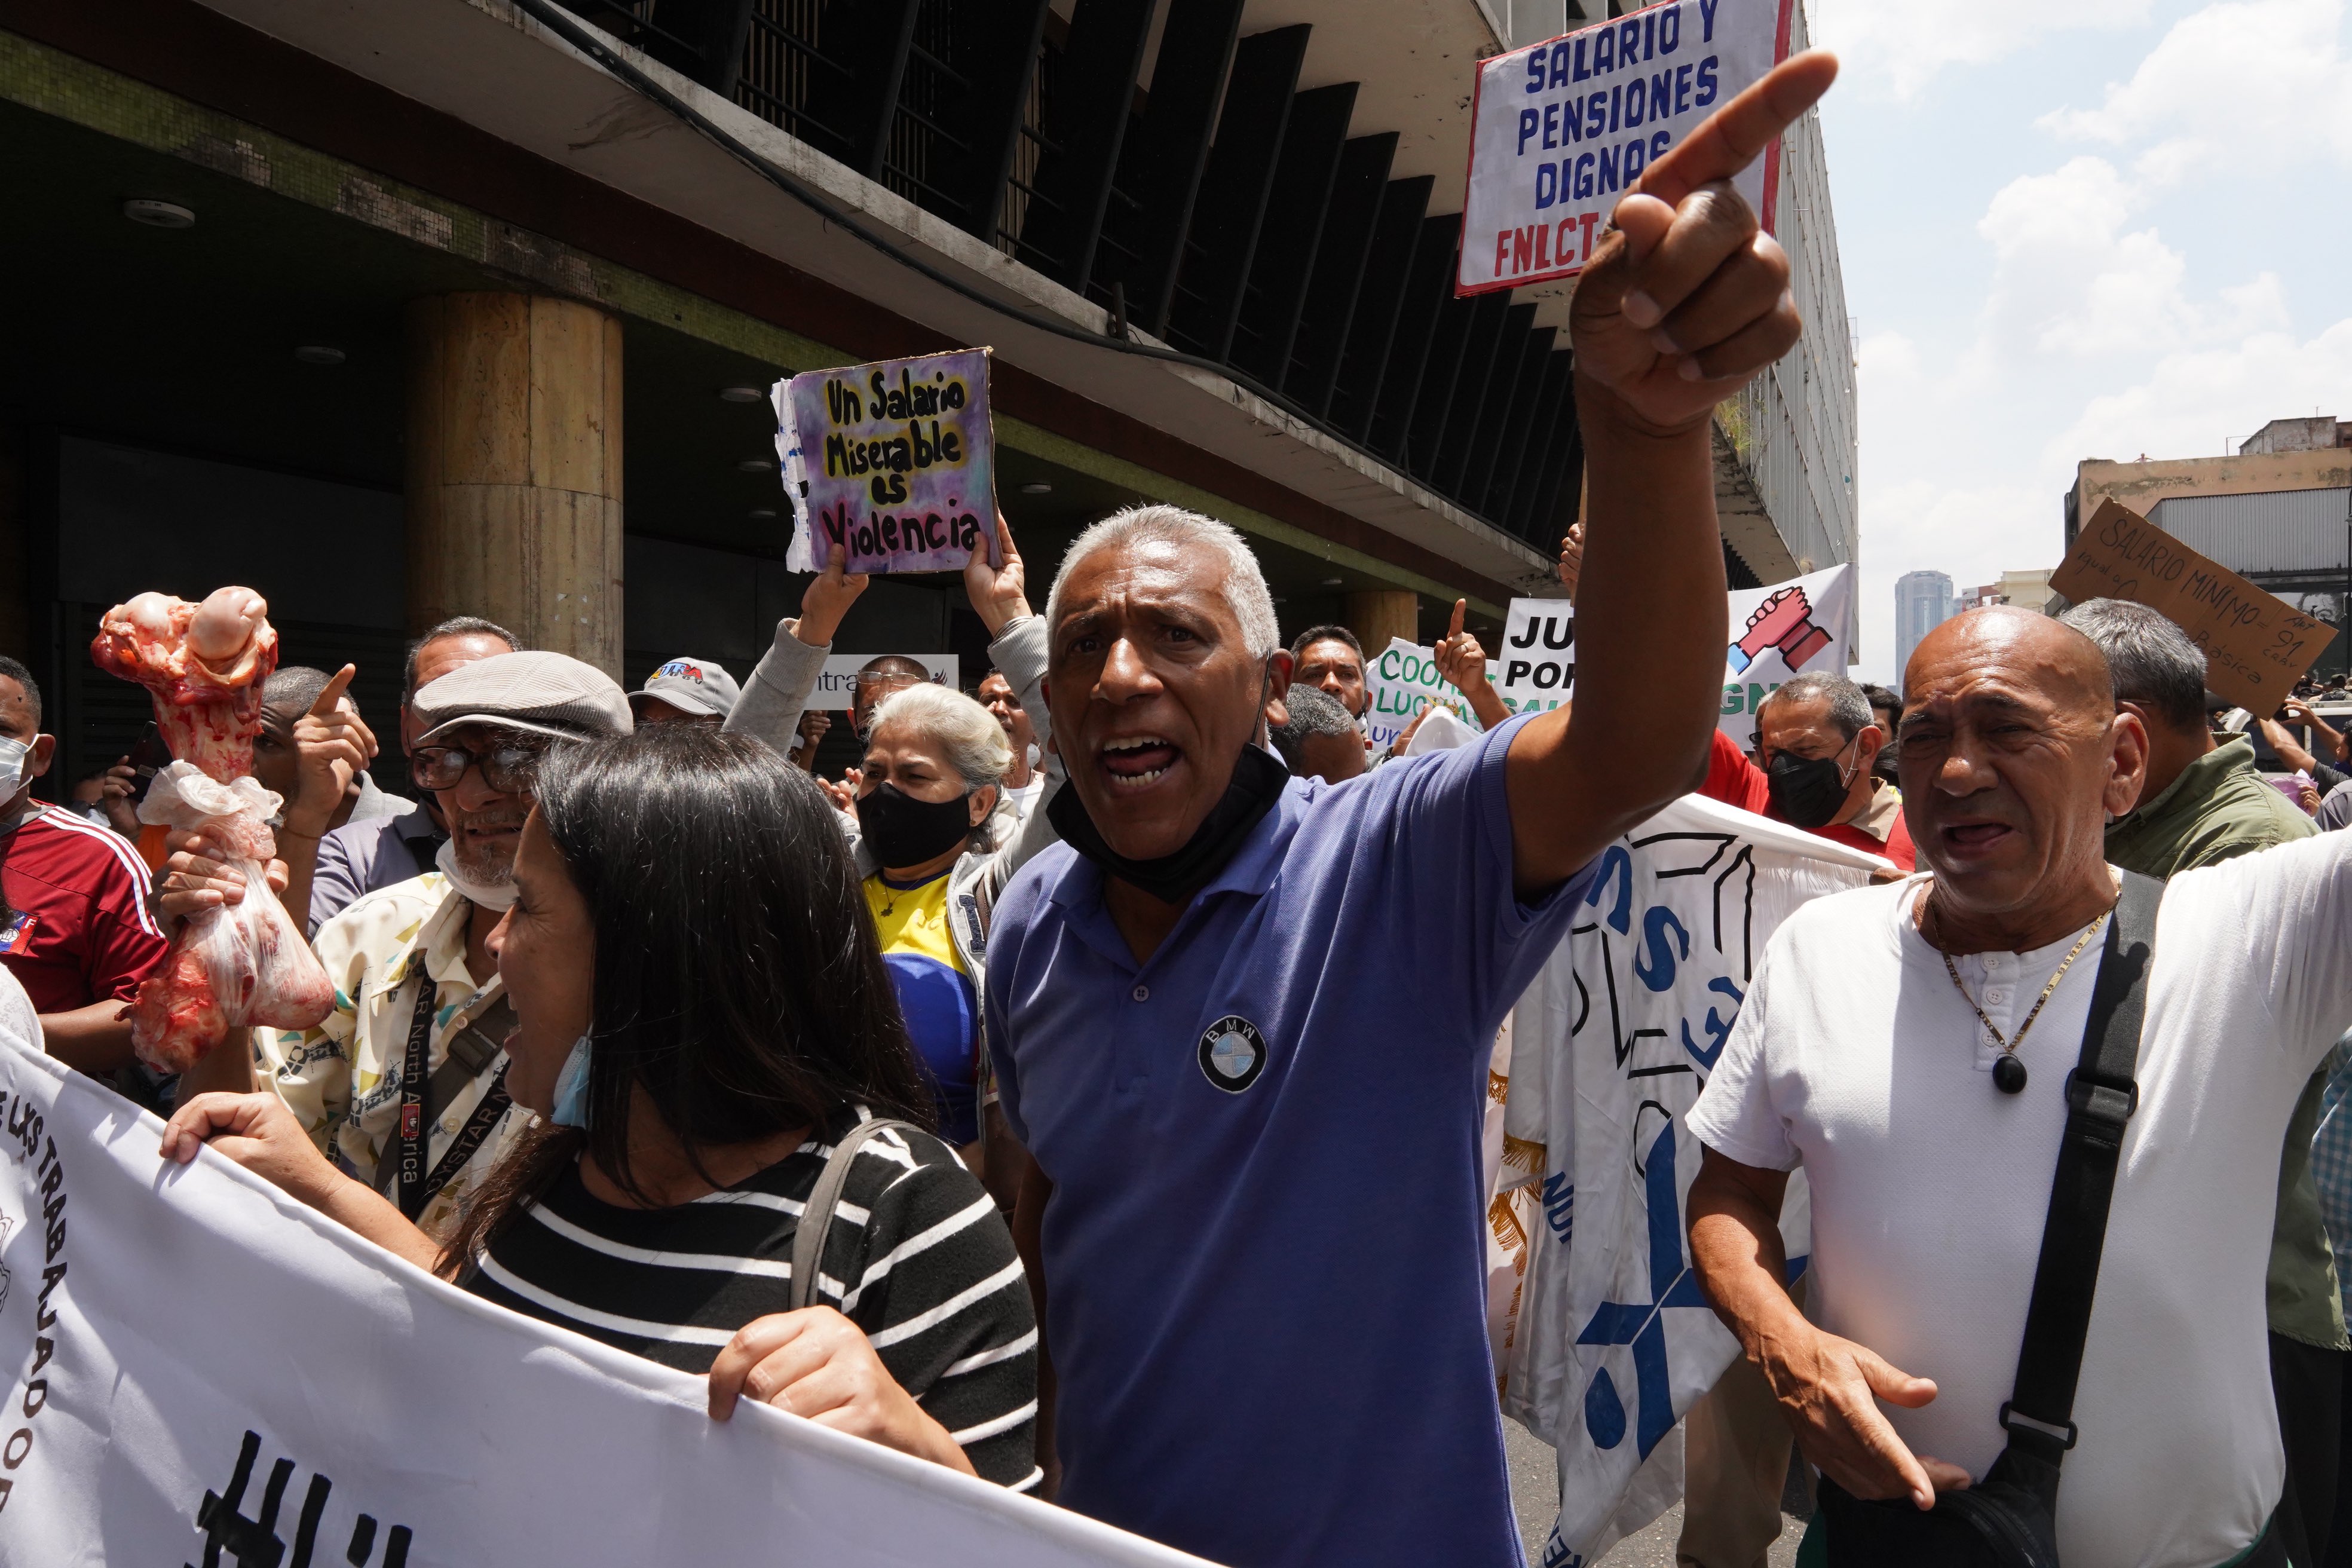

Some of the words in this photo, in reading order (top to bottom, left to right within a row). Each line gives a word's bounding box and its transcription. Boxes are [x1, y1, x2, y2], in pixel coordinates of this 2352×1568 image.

[1526, 4, 1680, 94] SALARIO
[1698, 0, 1719, 44] Y
[1517, 55, 1719, 155] PENSIONES
[827, 378, 862, 425] Un
[870, 368, 965, 420] Salario
[826, 419, 961, 477] Miserable
[871, 474, 907, 505] es
[822, 498, 981, 558] Violencia
[2100, 518, 2185, 581] SALARIO
[2271, 630, 2305, 657] 91
[405, 1024, 425, 1086] North
[1206, 1019, 1255, 1043] BMW
